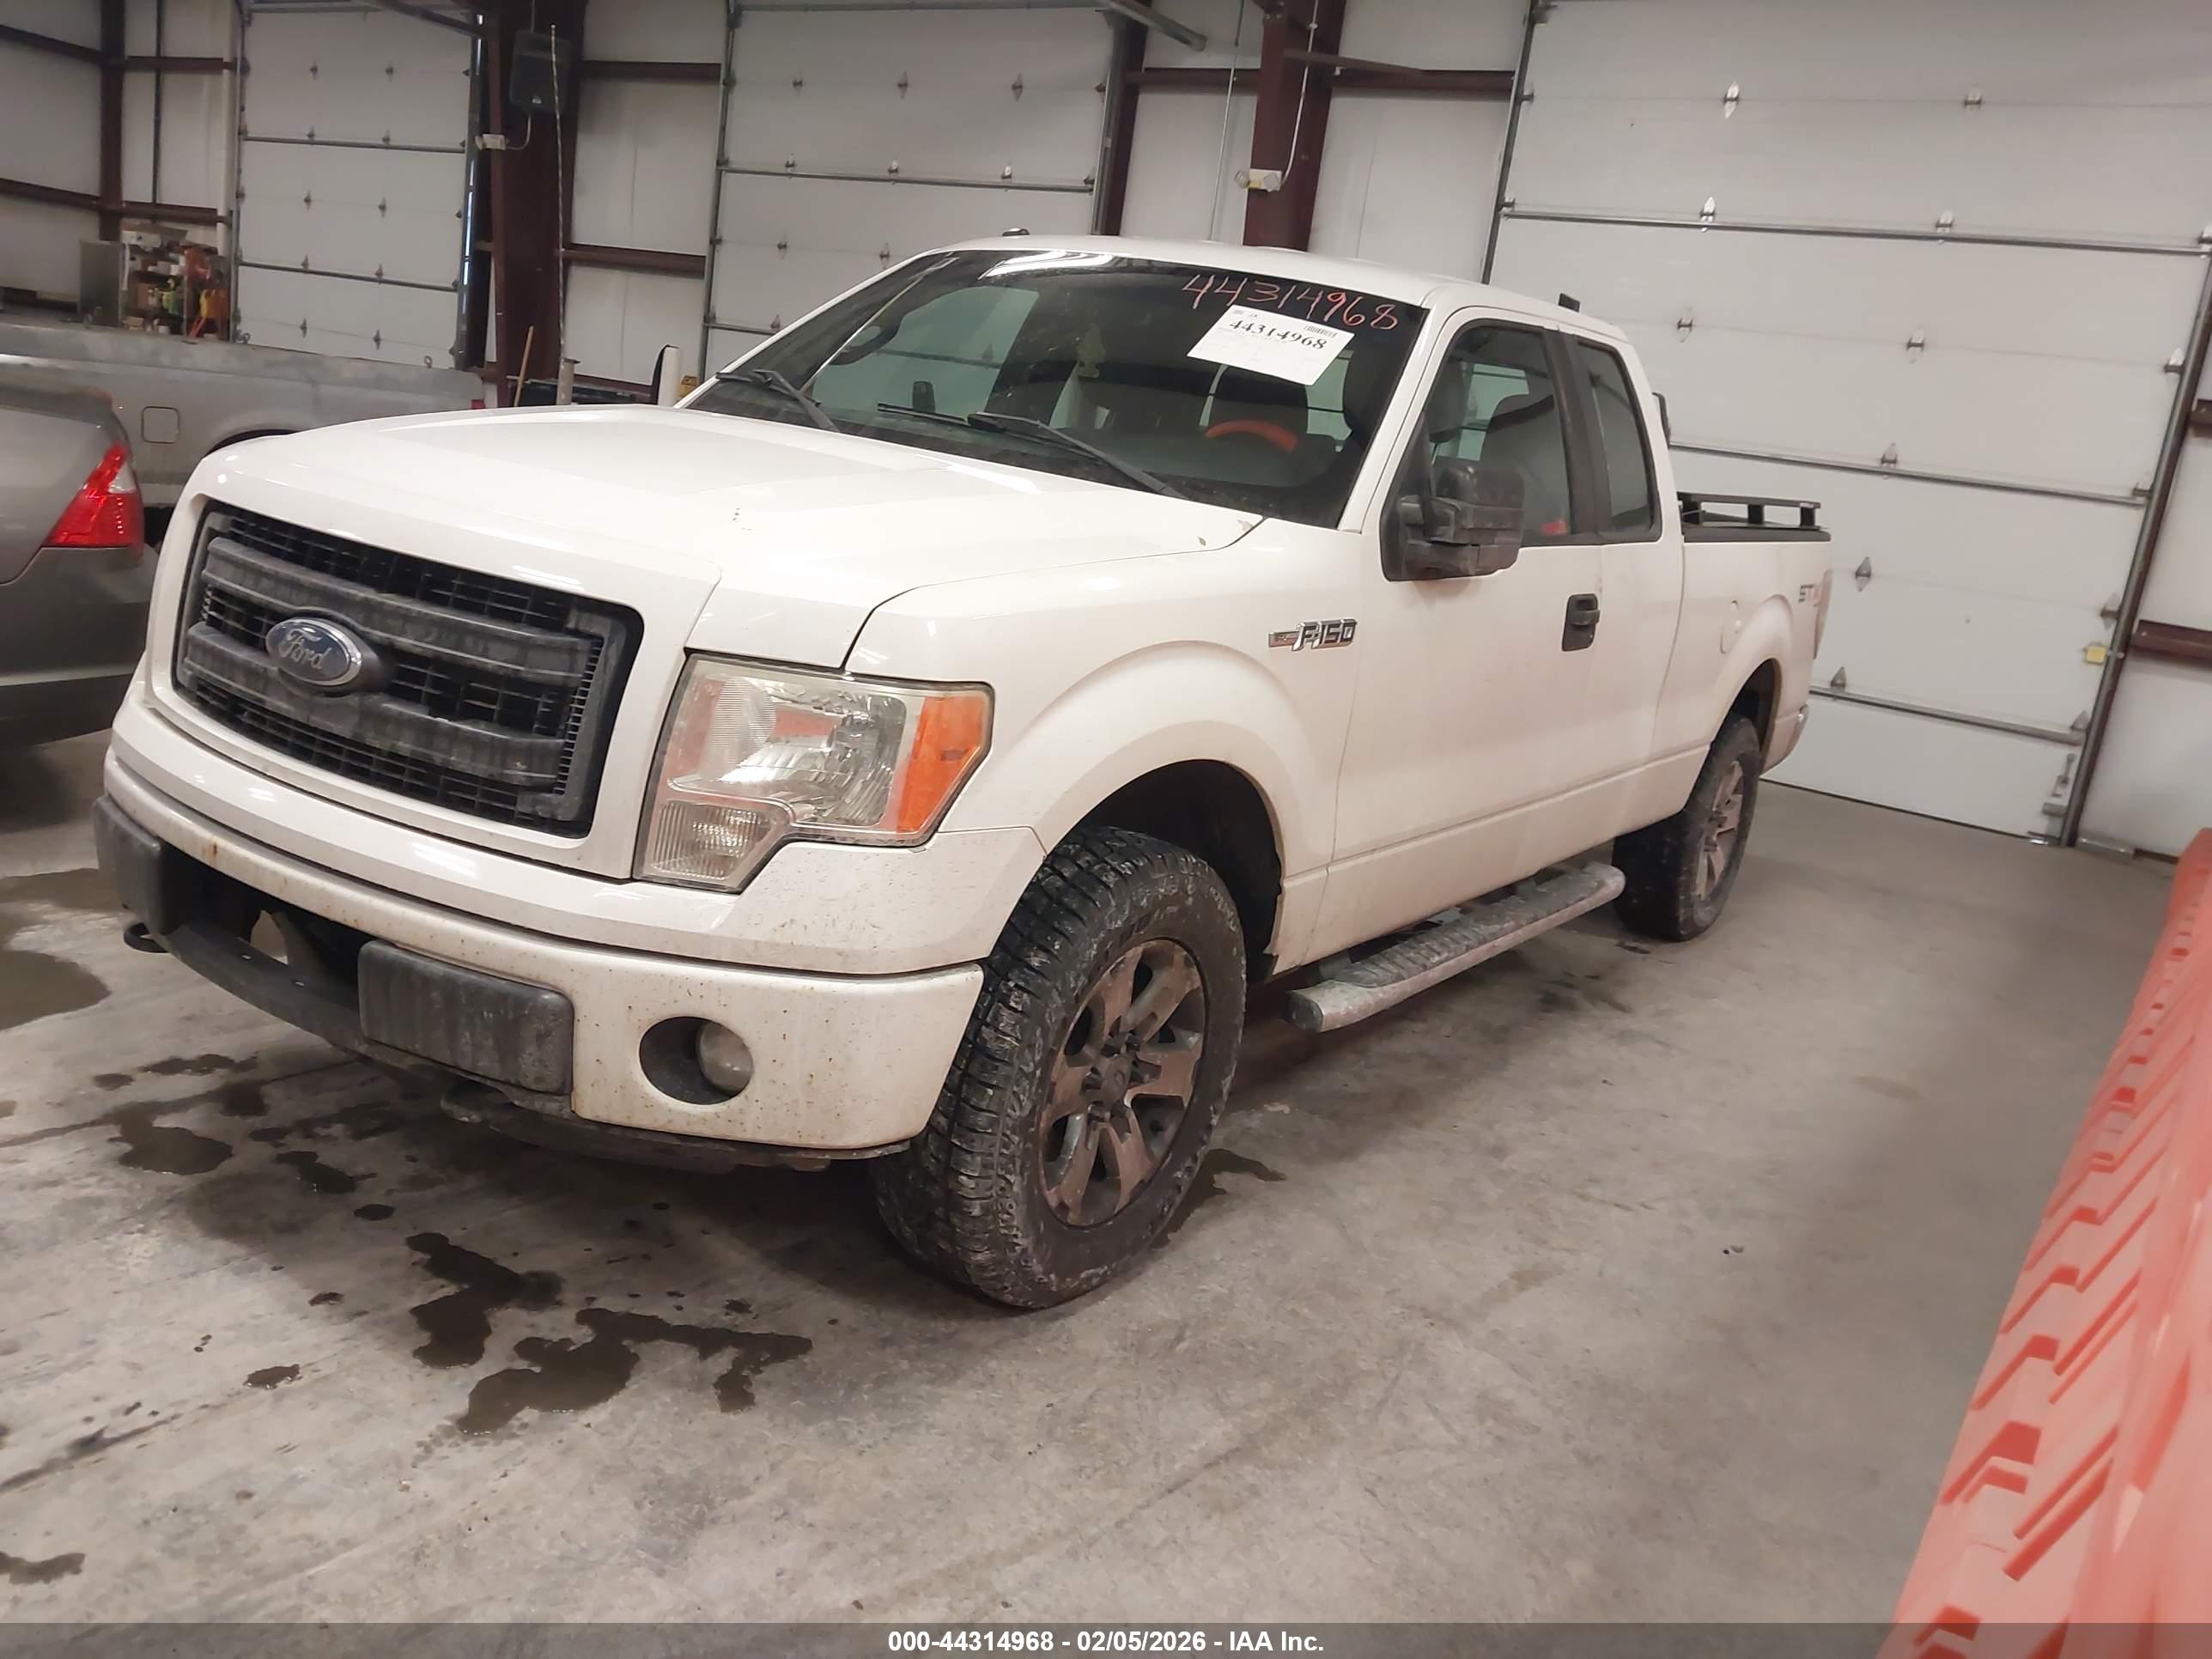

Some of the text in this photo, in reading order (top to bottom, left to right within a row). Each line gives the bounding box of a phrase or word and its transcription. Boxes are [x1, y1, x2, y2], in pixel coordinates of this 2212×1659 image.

[1182, 275, 1400, 330] 44314968
[1230, 320, 1328, 349] 44314968
[278, 629, 333, 669] Ford
